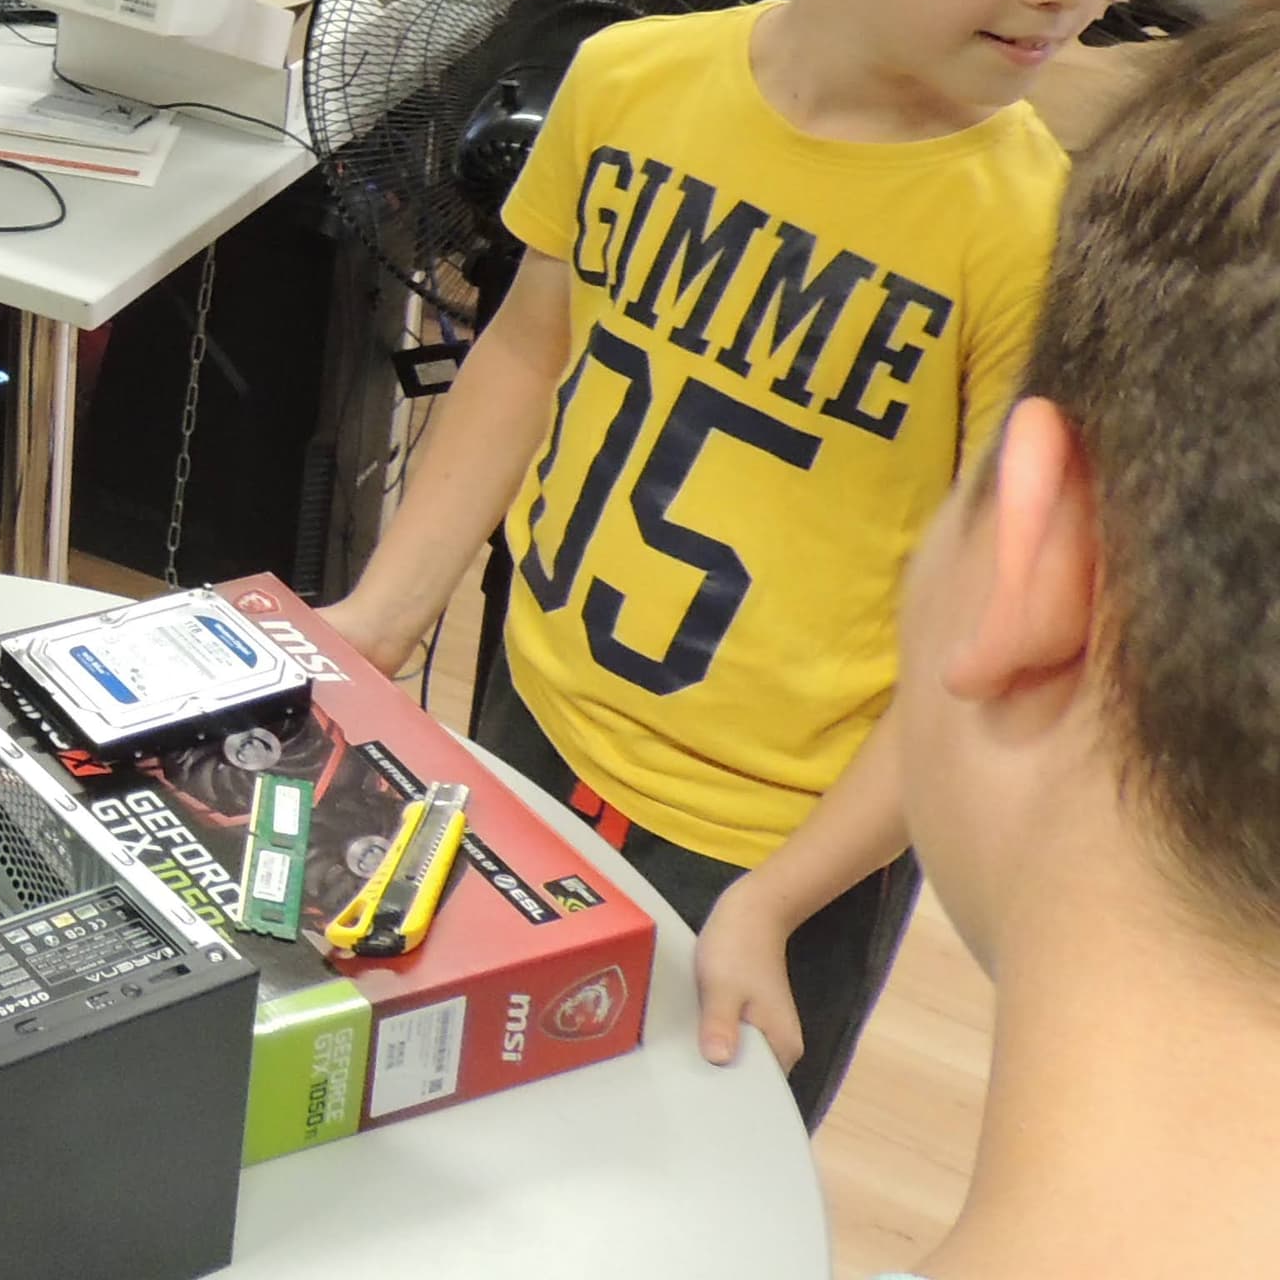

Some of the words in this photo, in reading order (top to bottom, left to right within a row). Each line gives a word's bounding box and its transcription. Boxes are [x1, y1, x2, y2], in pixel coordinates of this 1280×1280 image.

[573, 145, 955, 441] GIMME
[519, 320, 822, 696] 05
[259, 620, 351, 685] msi
[91, 798, 163, 856] GTX
[509, 887, 546, 921] ESL
[502, 993, 531, 1063] msi
[306, 1078, 329, 1130] 1050
